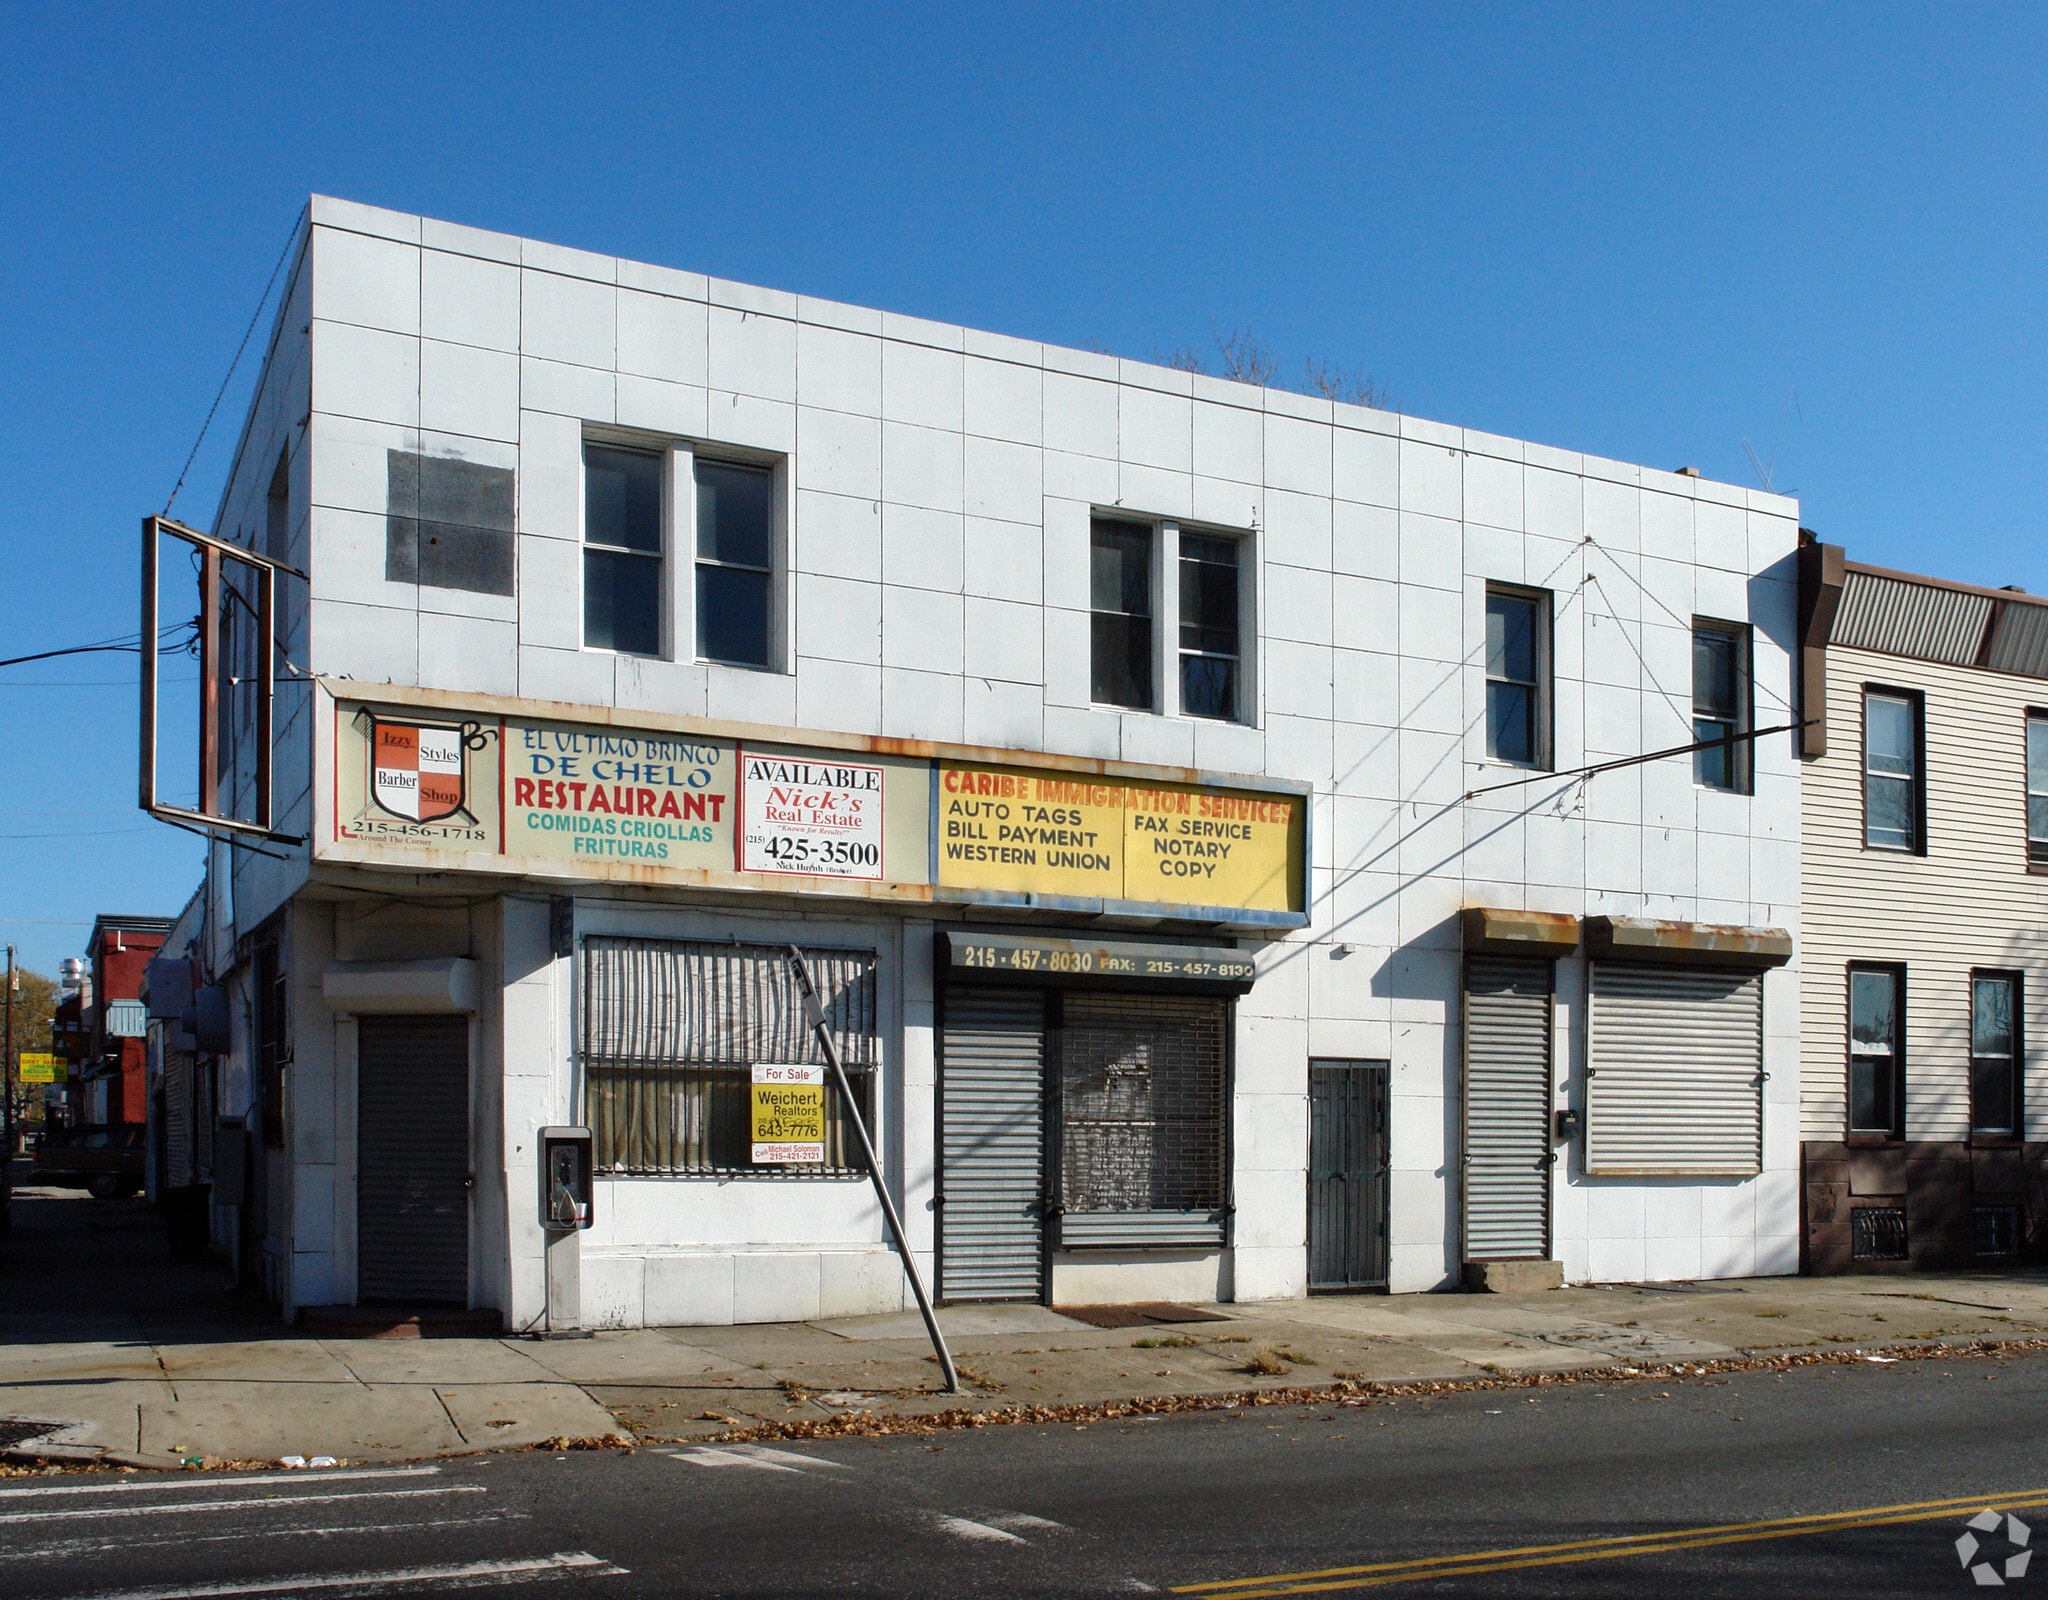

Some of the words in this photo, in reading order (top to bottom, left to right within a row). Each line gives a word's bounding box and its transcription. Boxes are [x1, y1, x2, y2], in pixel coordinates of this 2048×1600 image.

[383, 731, 412, 747] Izzy
[523, 728, 548, 750] EL
[644, 740, 721, 766] BRINCO
[420, 746, 460, 763] Styles
[377, 770, 418, 787] Barber
[529, 753, 581, 777] DE
[591, 760, 712, 788] CHELO
[747, 760, 880, 793] AVAILABLE
[420, 788, 458, 805] Shop
[514, 777, 726, 823] RESTAURANT
[764, 786, 863, 813] Nick's
[944, 769, 1029, 801] CARIBE
[1035, 778, 1192, 816] IMMIGRATION
[1197, 793, 1294, 825] SERVICES
[764, 806, 802, 823] Real
[812, 809, 863, 829] Estate
[948, 799, 1010, 821] AUTO
[1021, 804, 1082, 827] TAGS
[353, 821, 486, 841] 215-456-1718
[527, 812, 617, 836] COMIDAS
[620, 820, 713, 843] CRIOLLAS
[806, 827, 817, 835] for
[947, 819, 988, 841] BILL
[998, 824, 1098, 849] PAYMENT
[1134, 814, 1169, 833] FAX
[1178, 819, 1252, 841] SERVICE
[358, 833, 387, 842] Around
[389, 835, 404, 844] The
[405, 837, 432, 846] Corner
[573, 836, 669, 859] FRITURAS
[745, 834, 766, 845] (215)
[1153, 836, 1232, 860] NOTARY
[763, 836, 879, 867] 425-3500
[946, 842, 1036, 866] WESTERN
[1046, 850, 1110, 872] UNION
[776, 860, 795, 872] Nick
[1159, 859, 1217, 879] COPY
[1096, 957, 1134, 973] FAX:
[766, 1069, 783, 1080] For
[787, 1069, 809, 1080] Sale
[758, 1091, 817, 1105] Weichert
[774, 1106, 817, 1116] Realtors
[758, 1125, 818, 1137] 643-7776
[755, 1150, 768, 1158] Cell
[770, 1152, 819, 1161] 215-421-2121
